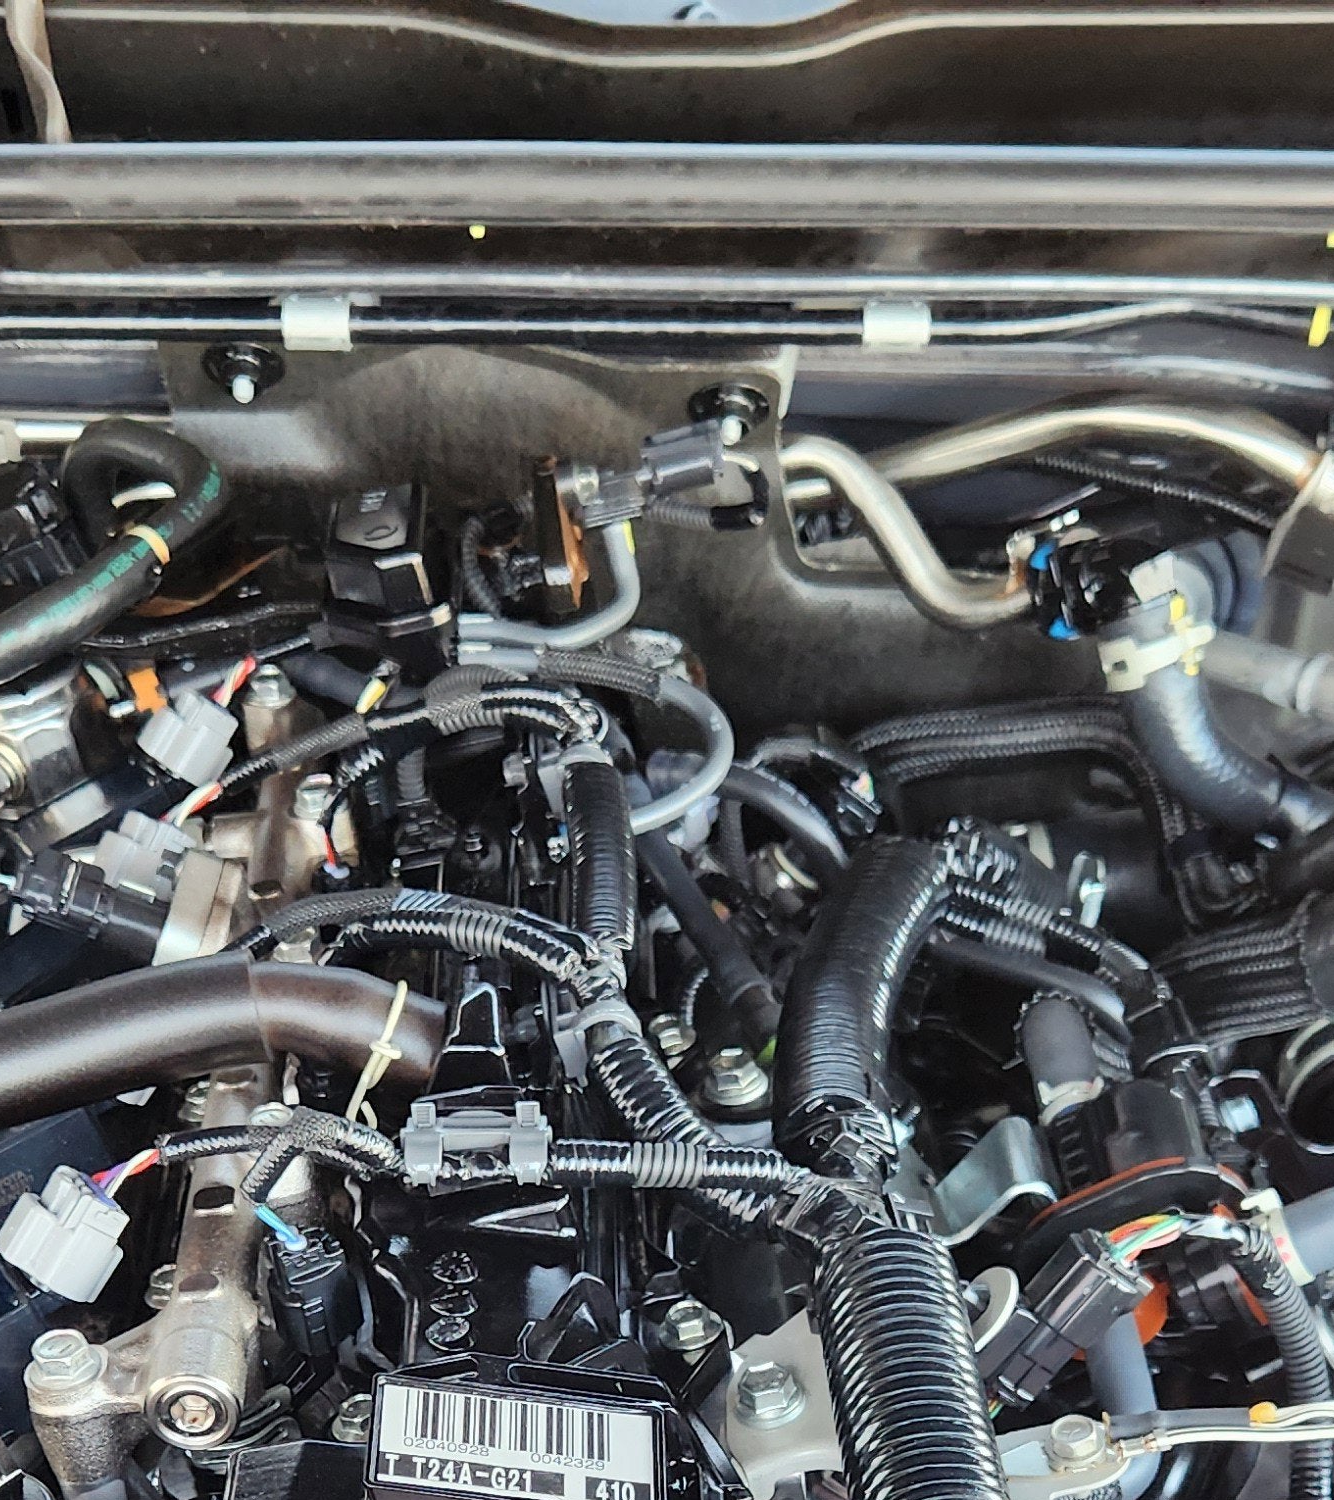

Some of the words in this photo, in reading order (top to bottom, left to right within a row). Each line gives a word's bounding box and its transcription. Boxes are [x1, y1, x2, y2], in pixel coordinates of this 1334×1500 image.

[403, 1436, 490, 1457] 02040928
[530, 1453, 605, 1472] 0042329
[384, 1454, 401, 1476] T
[411, 1456, 533, 1493] T24A-G21
